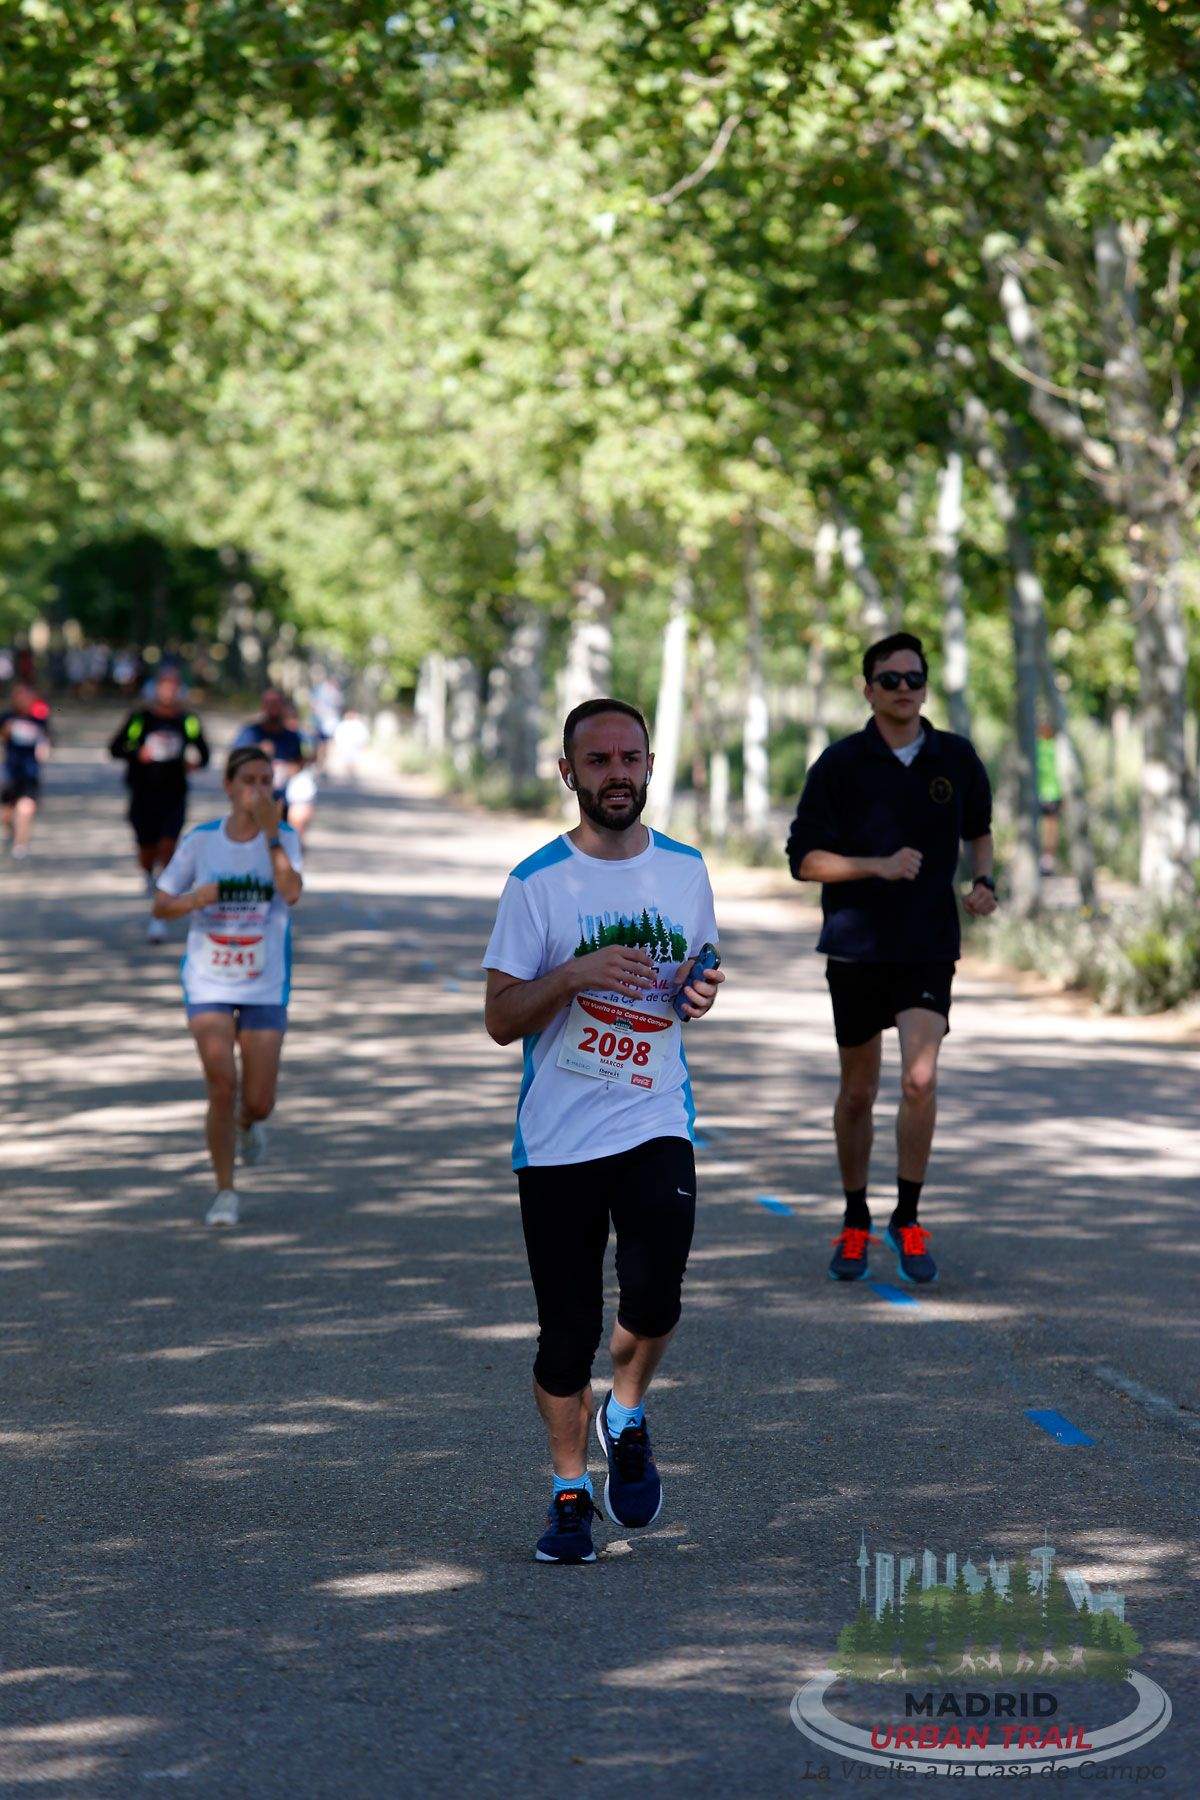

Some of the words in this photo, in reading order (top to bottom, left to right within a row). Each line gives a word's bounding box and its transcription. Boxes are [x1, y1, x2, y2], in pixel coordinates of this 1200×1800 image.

[212, 951, 255, 967] 2241
[646, 992, 659, 1002] de
[590, 1002, 610, 1013] Vuelta
[624, 1012, 639, 1020] Casa
[647, 1017, 668, 1028] Campo
[577, 1027, 651, 1066] 2098
[599, 1058, 624, 1069] MARCOS
